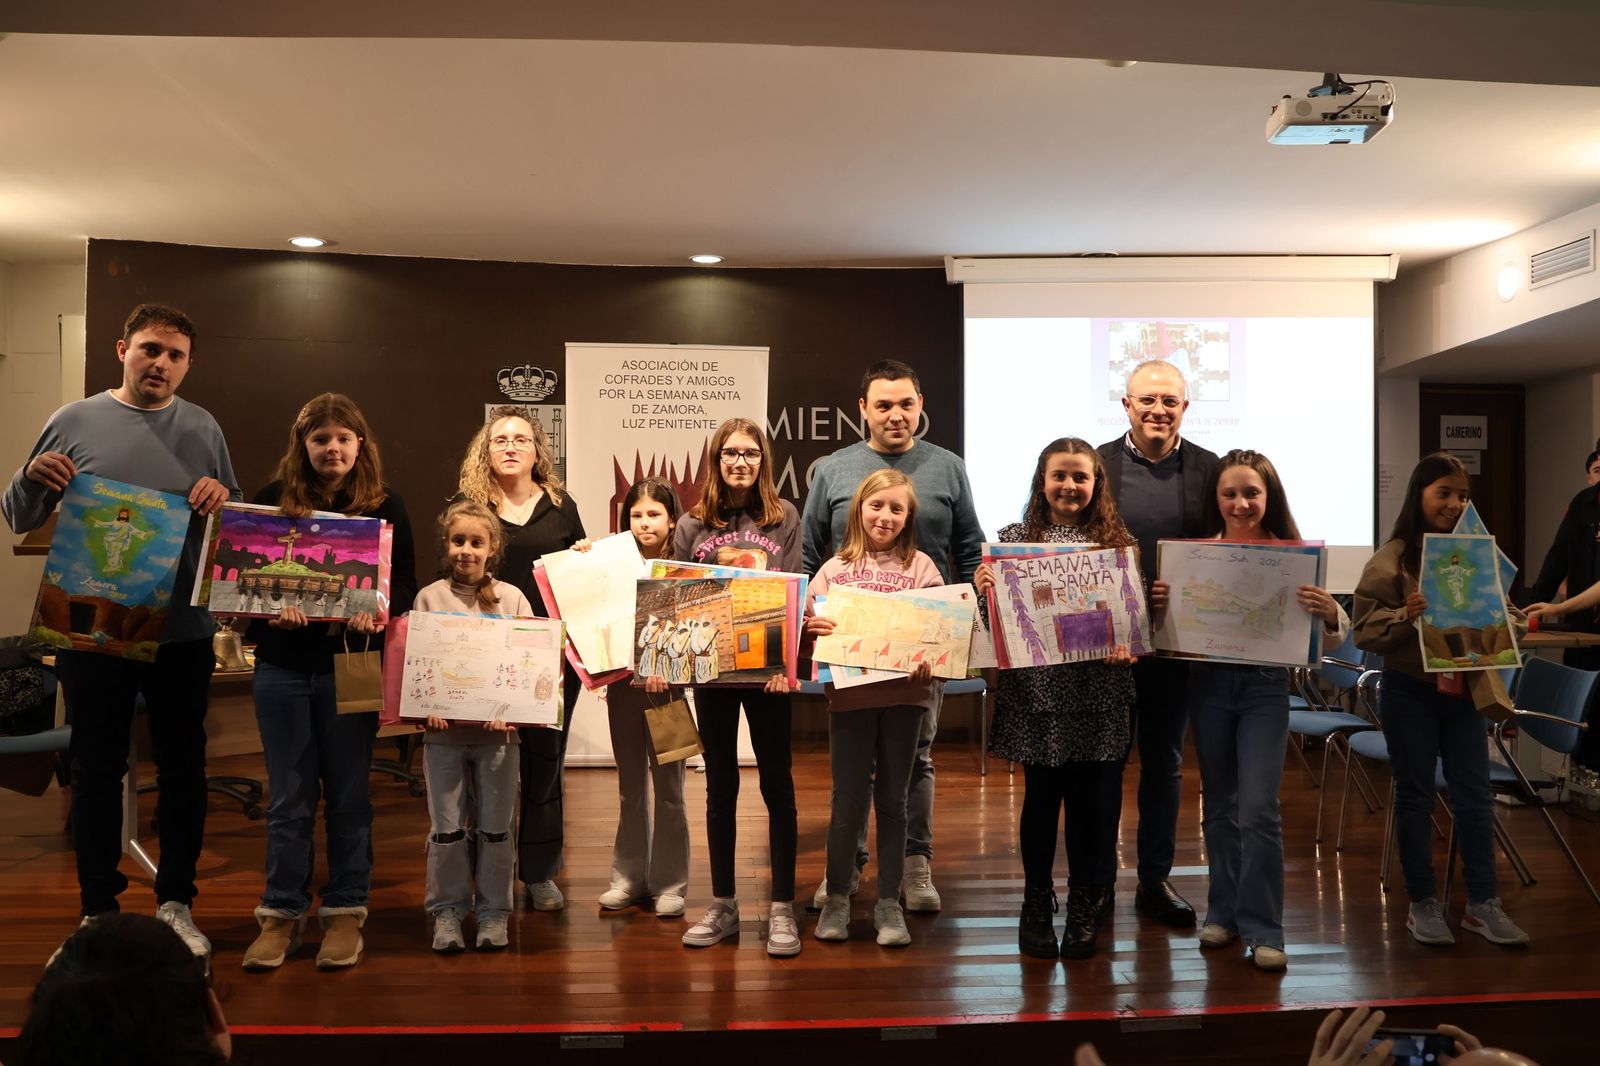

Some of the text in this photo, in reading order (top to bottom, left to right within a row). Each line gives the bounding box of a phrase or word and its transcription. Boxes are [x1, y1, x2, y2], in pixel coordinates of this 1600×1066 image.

[621, 359, 719, 372] ASOCIACIÓN DE
[604, 374, 735, 386] COFRADES Y AMIGOS
[599, 389, 741, 400] POR LA SEMANA SANTA
[632, 404, 708, 416] DE ZAMORA,
[622, 418, 718, 430] LUZ PENITENTE
[1445, 425, 1482, 439] CAMERINO
[744, 530, 782, 556] toast
[1015, 554, 1093, 579] SEMANA
[1053, 570, 1115, 590] SANTA
